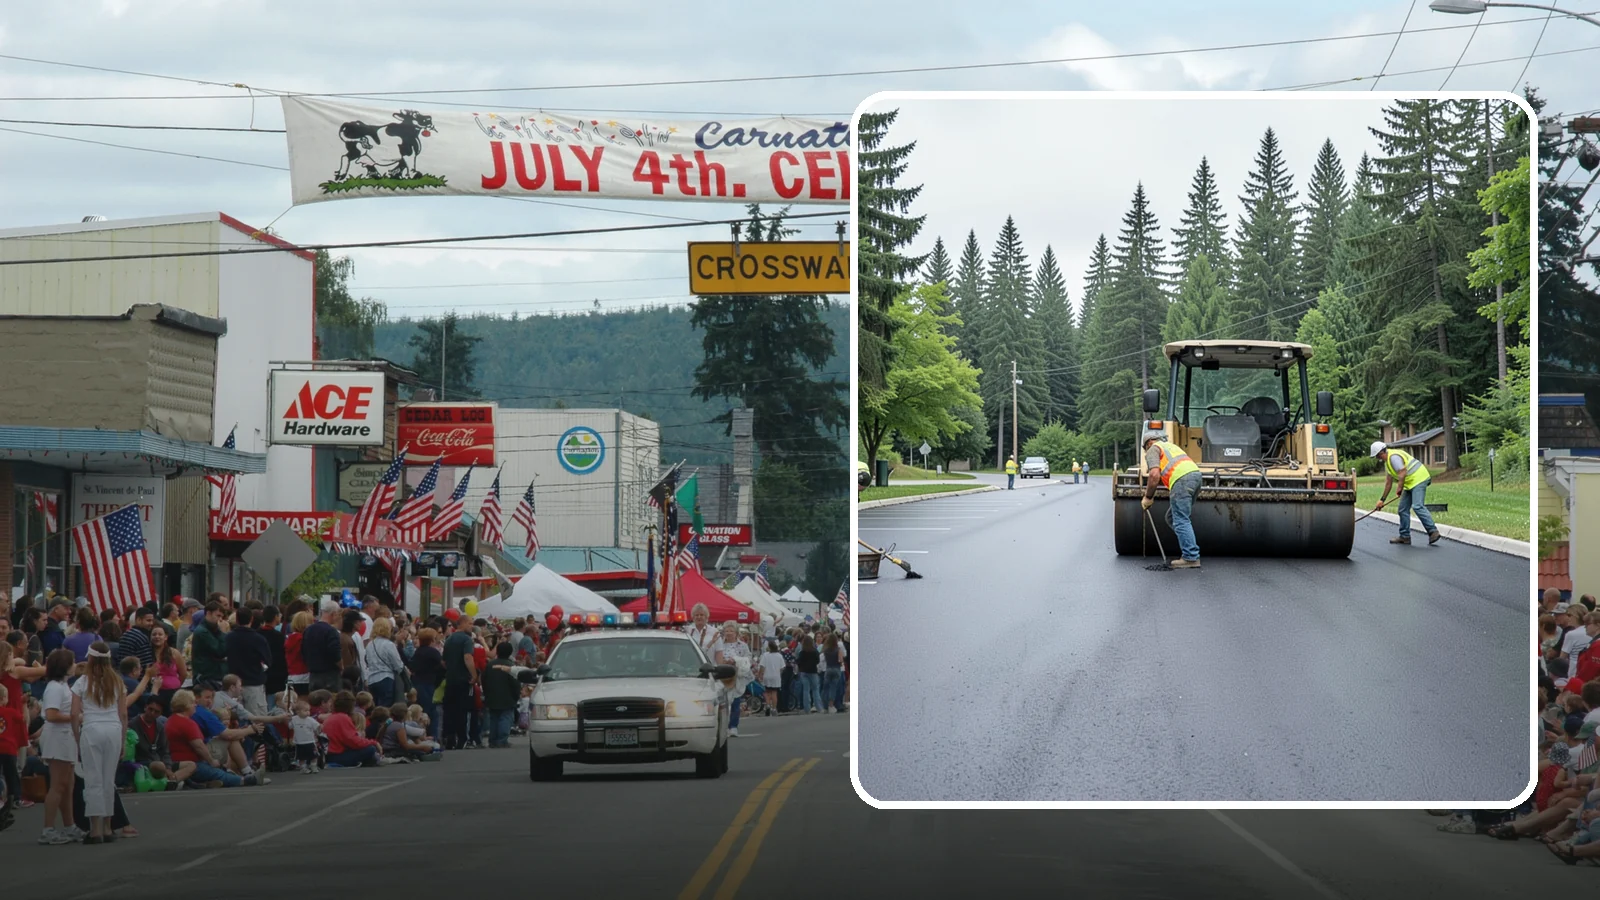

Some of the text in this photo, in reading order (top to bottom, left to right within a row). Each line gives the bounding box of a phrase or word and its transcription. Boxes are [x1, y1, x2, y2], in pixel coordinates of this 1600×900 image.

[481, 141, 604, 192] JULY
[632, 150, 746, 198] 4th.
[696, 254, 850, 280] CROSSWA
[282, 380, 373, 420] ACE
[405, 409, 485, 422] CEDAR LOG
[283, 421, 371, 436] Hardware
[353, 467, 386, 479] Simpl
[95, 485, 124, 495] Vincent
[126, 486, 136, 494] de
[137, 486, 155, 495] Paul
[699, 535, 730, 543] GLASS
